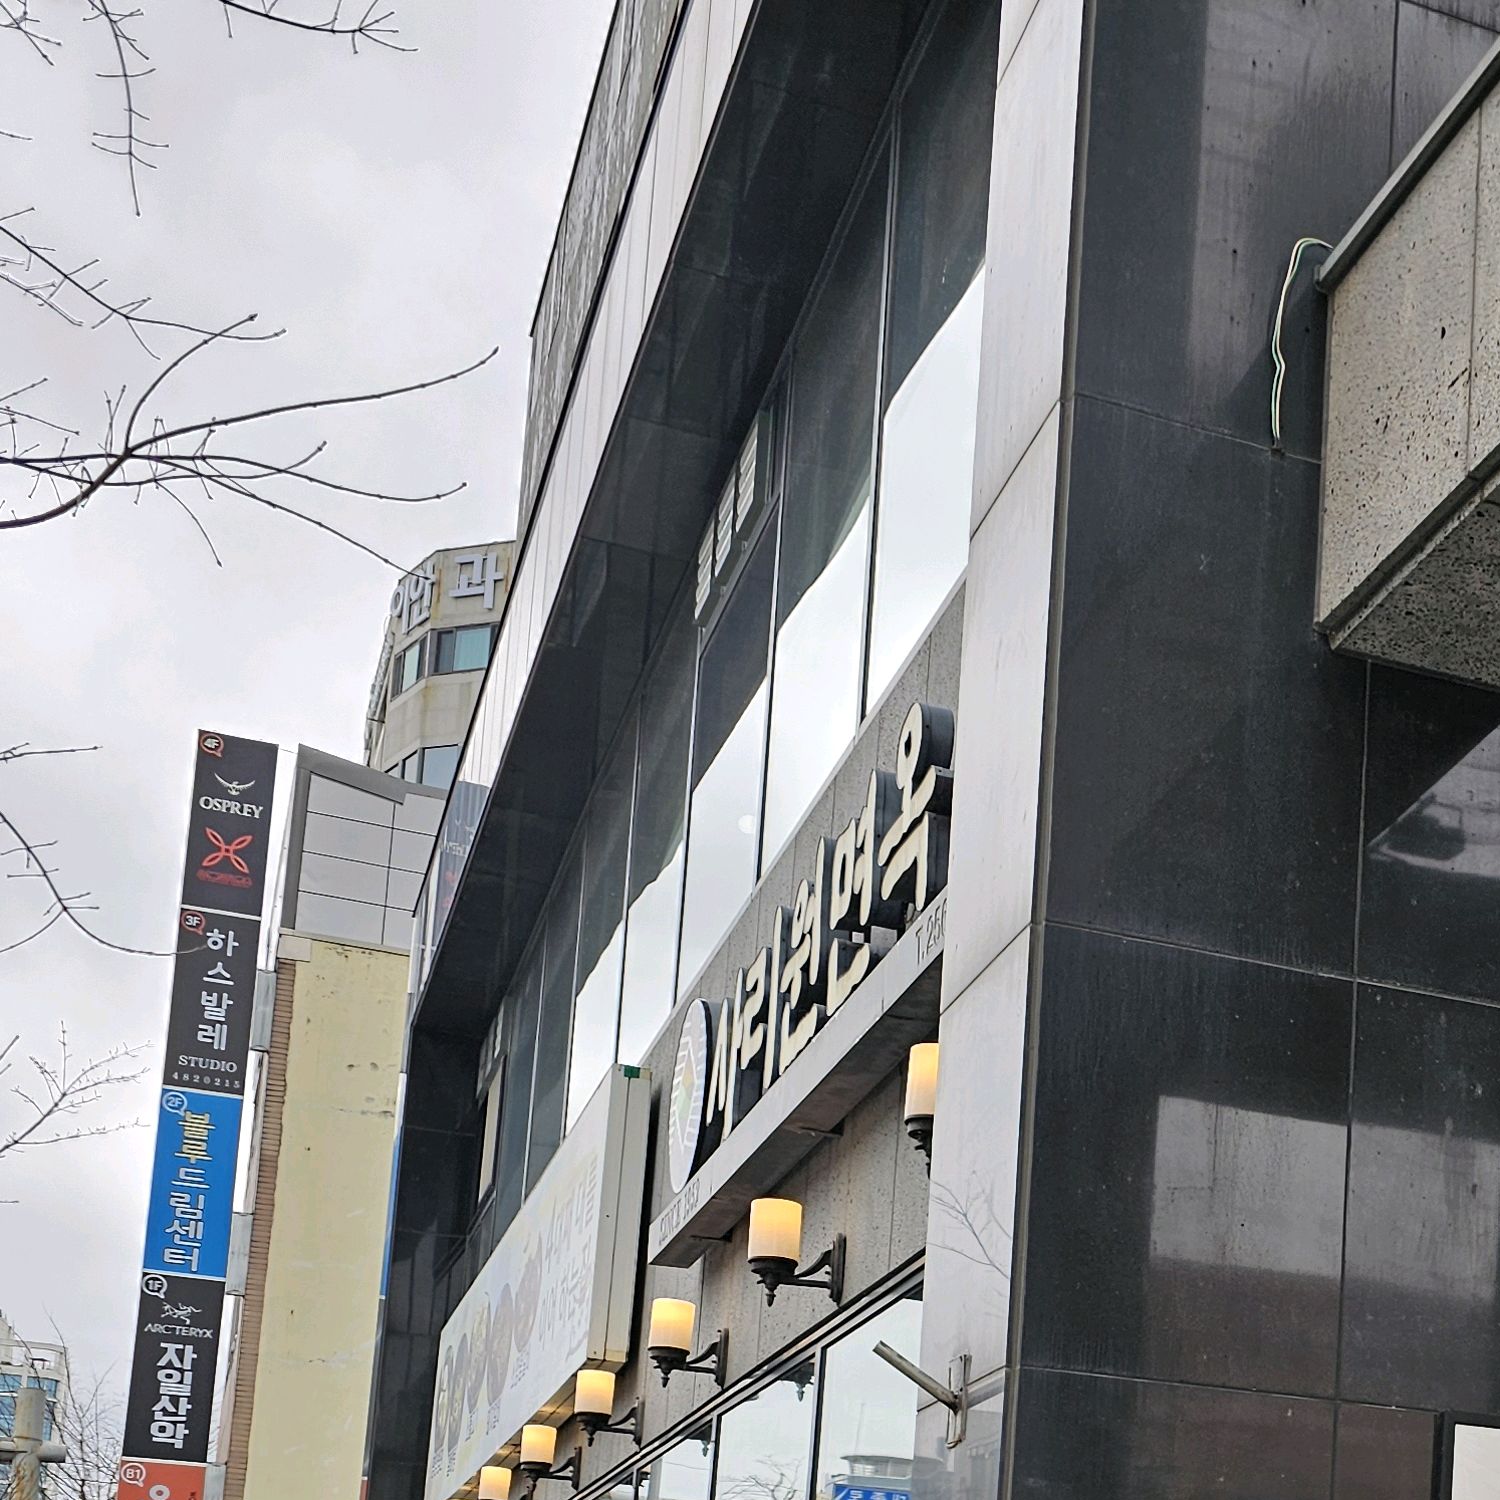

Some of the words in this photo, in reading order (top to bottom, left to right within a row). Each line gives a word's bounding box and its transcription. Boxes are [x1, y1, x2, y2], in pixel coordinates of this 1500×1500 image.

[199, 796, 264, 819] OSPREY
[185, 915, 201, 927] 3F
[706, 702, 954, 1141] 사리원면옥
[197, 928, 240, 1051] 하스발레
[178, 1055, 238, 1073] STUDIO
[167, 1097, 183, 1108] 2F
[163, 1110, 217, 1272] 블루드림센터
[148, 1280, 162, 1291] 1F
[150, 1342, 197, 1449] 자일산악
[126, 1468, 141, 1480] B1
